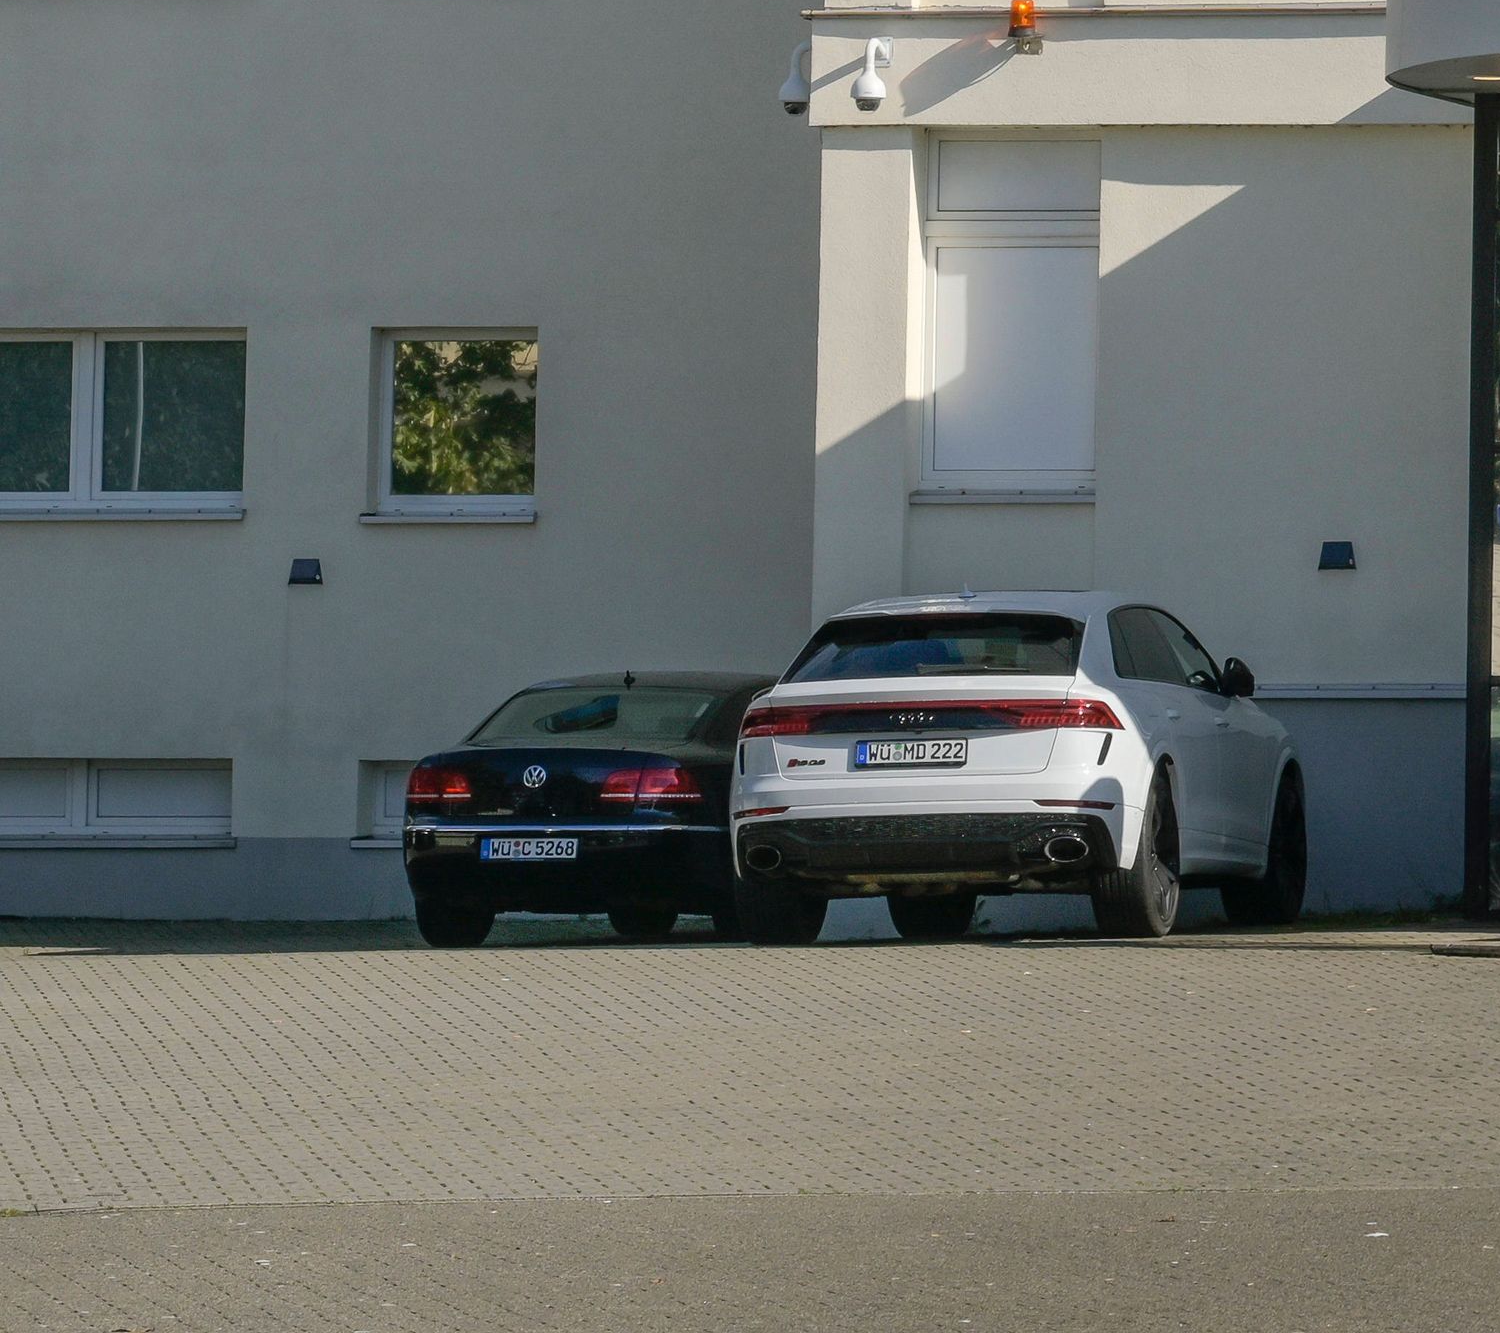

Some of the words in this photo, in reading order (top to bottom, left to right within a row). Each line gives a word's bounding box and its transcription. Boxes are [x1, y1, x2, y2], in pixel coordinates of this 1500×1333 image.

[868, 745, 891, 761] WÜ
[902, 744, 926, 760] MD
[931, 743, 963, 760] 222
[491, 840, 512, 856] WÜ
[522, 840, 531, 856] C
[535, 840, 575, 857] 5268
